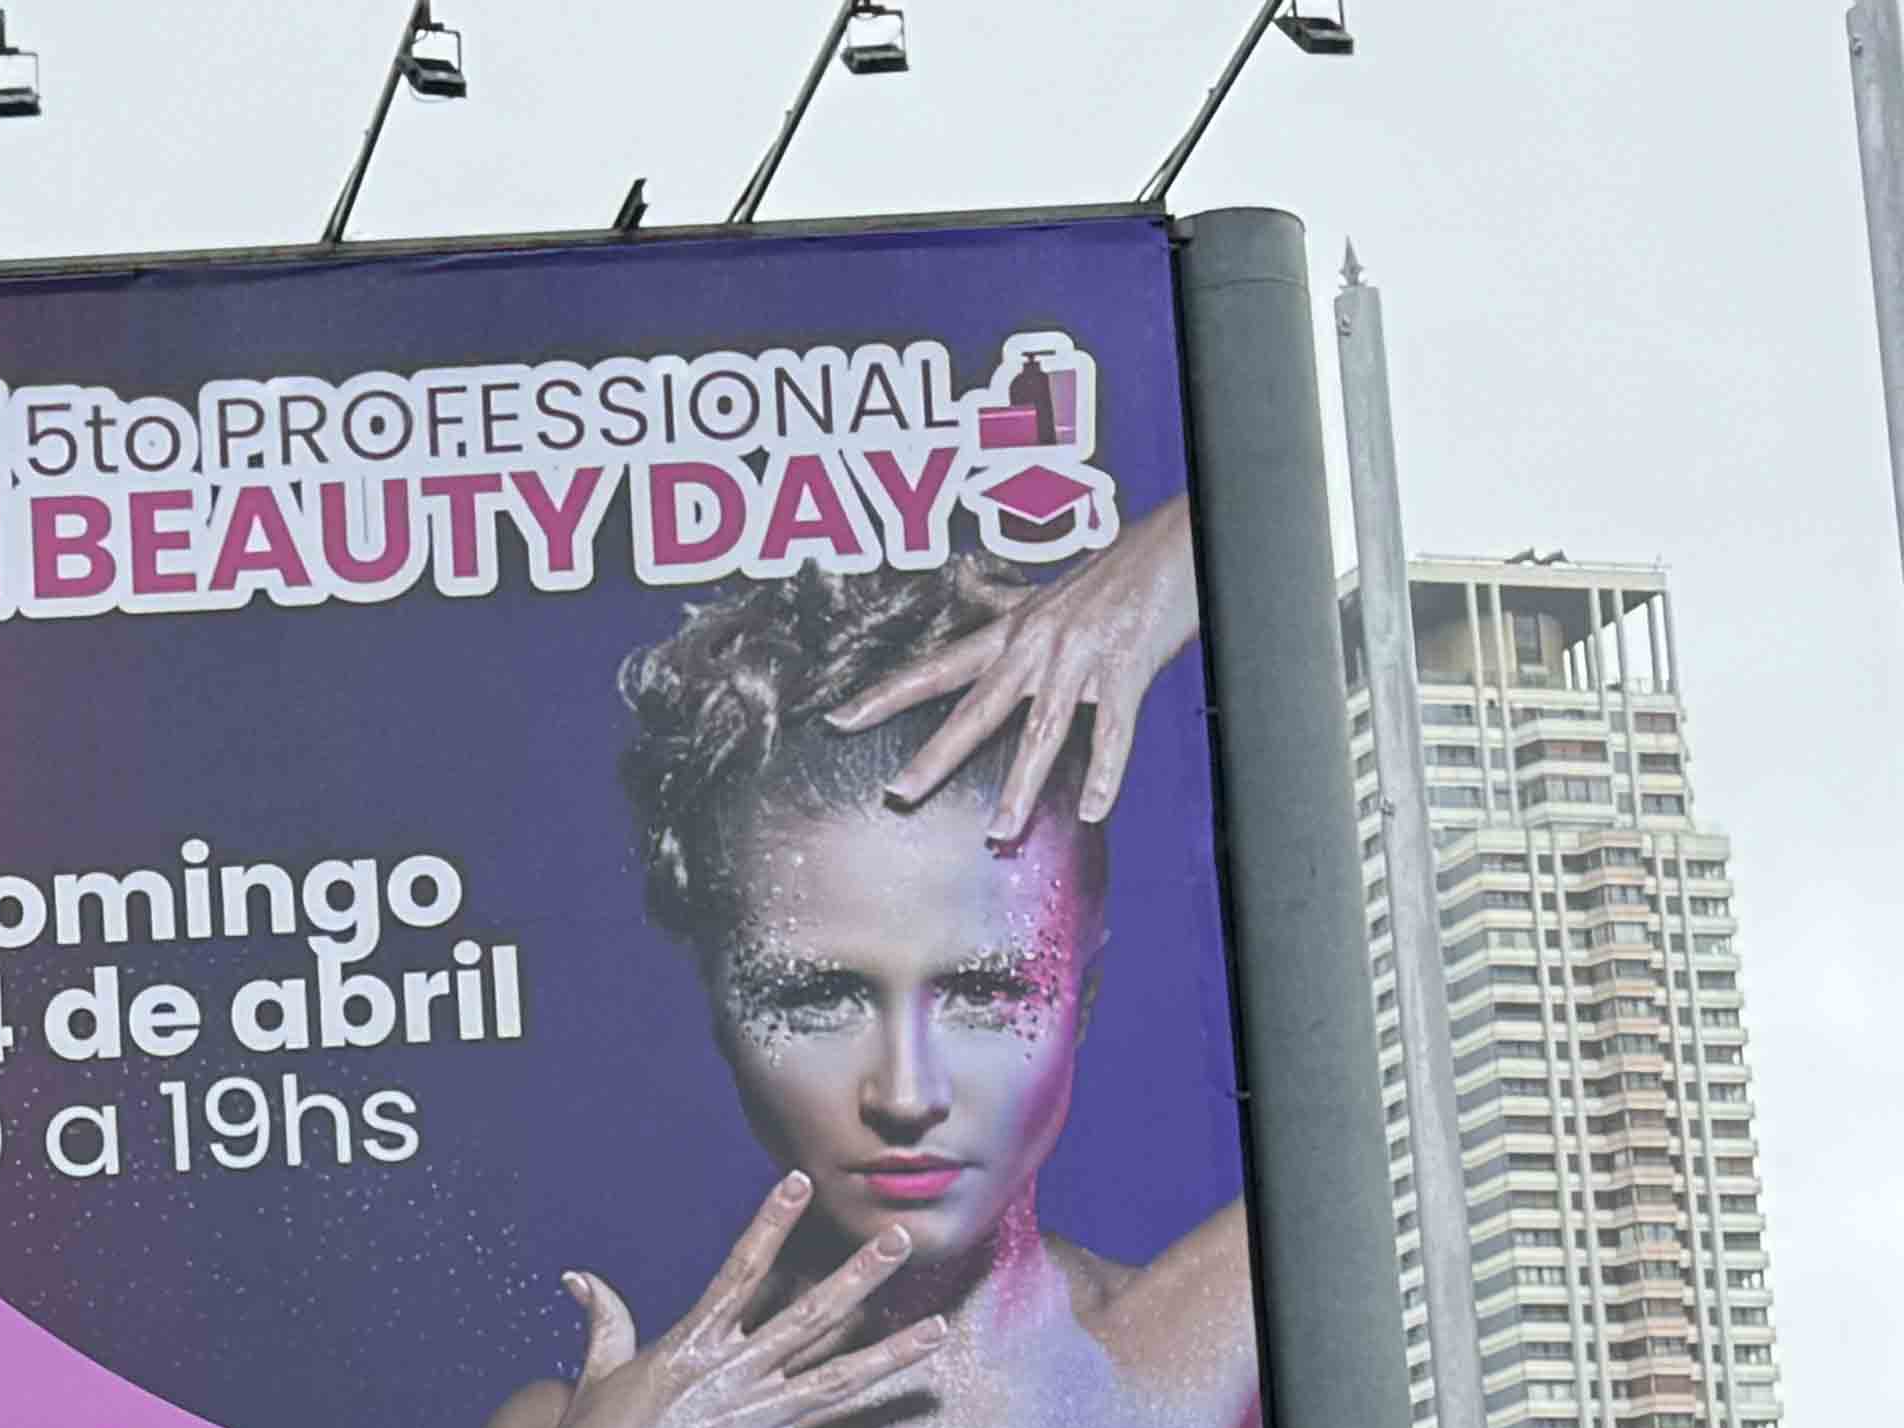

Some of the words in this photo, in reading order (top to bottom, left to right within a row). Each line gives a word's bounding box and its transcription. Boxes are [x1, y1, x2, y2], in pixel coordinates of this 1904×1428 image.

[26, 399, 177, 476] 5to
[215, 353, 960, 467] PROFESSIONAL
[30, 464, 606, 600] BEAUTY
[652, 446, 960, 571] DAY
[44, 966, 202, 1061] de
[231, 940, 522, 1053] abril
[45, 1103, 121, 1178] a
[160, 1073, 421, 1173] 19hs
